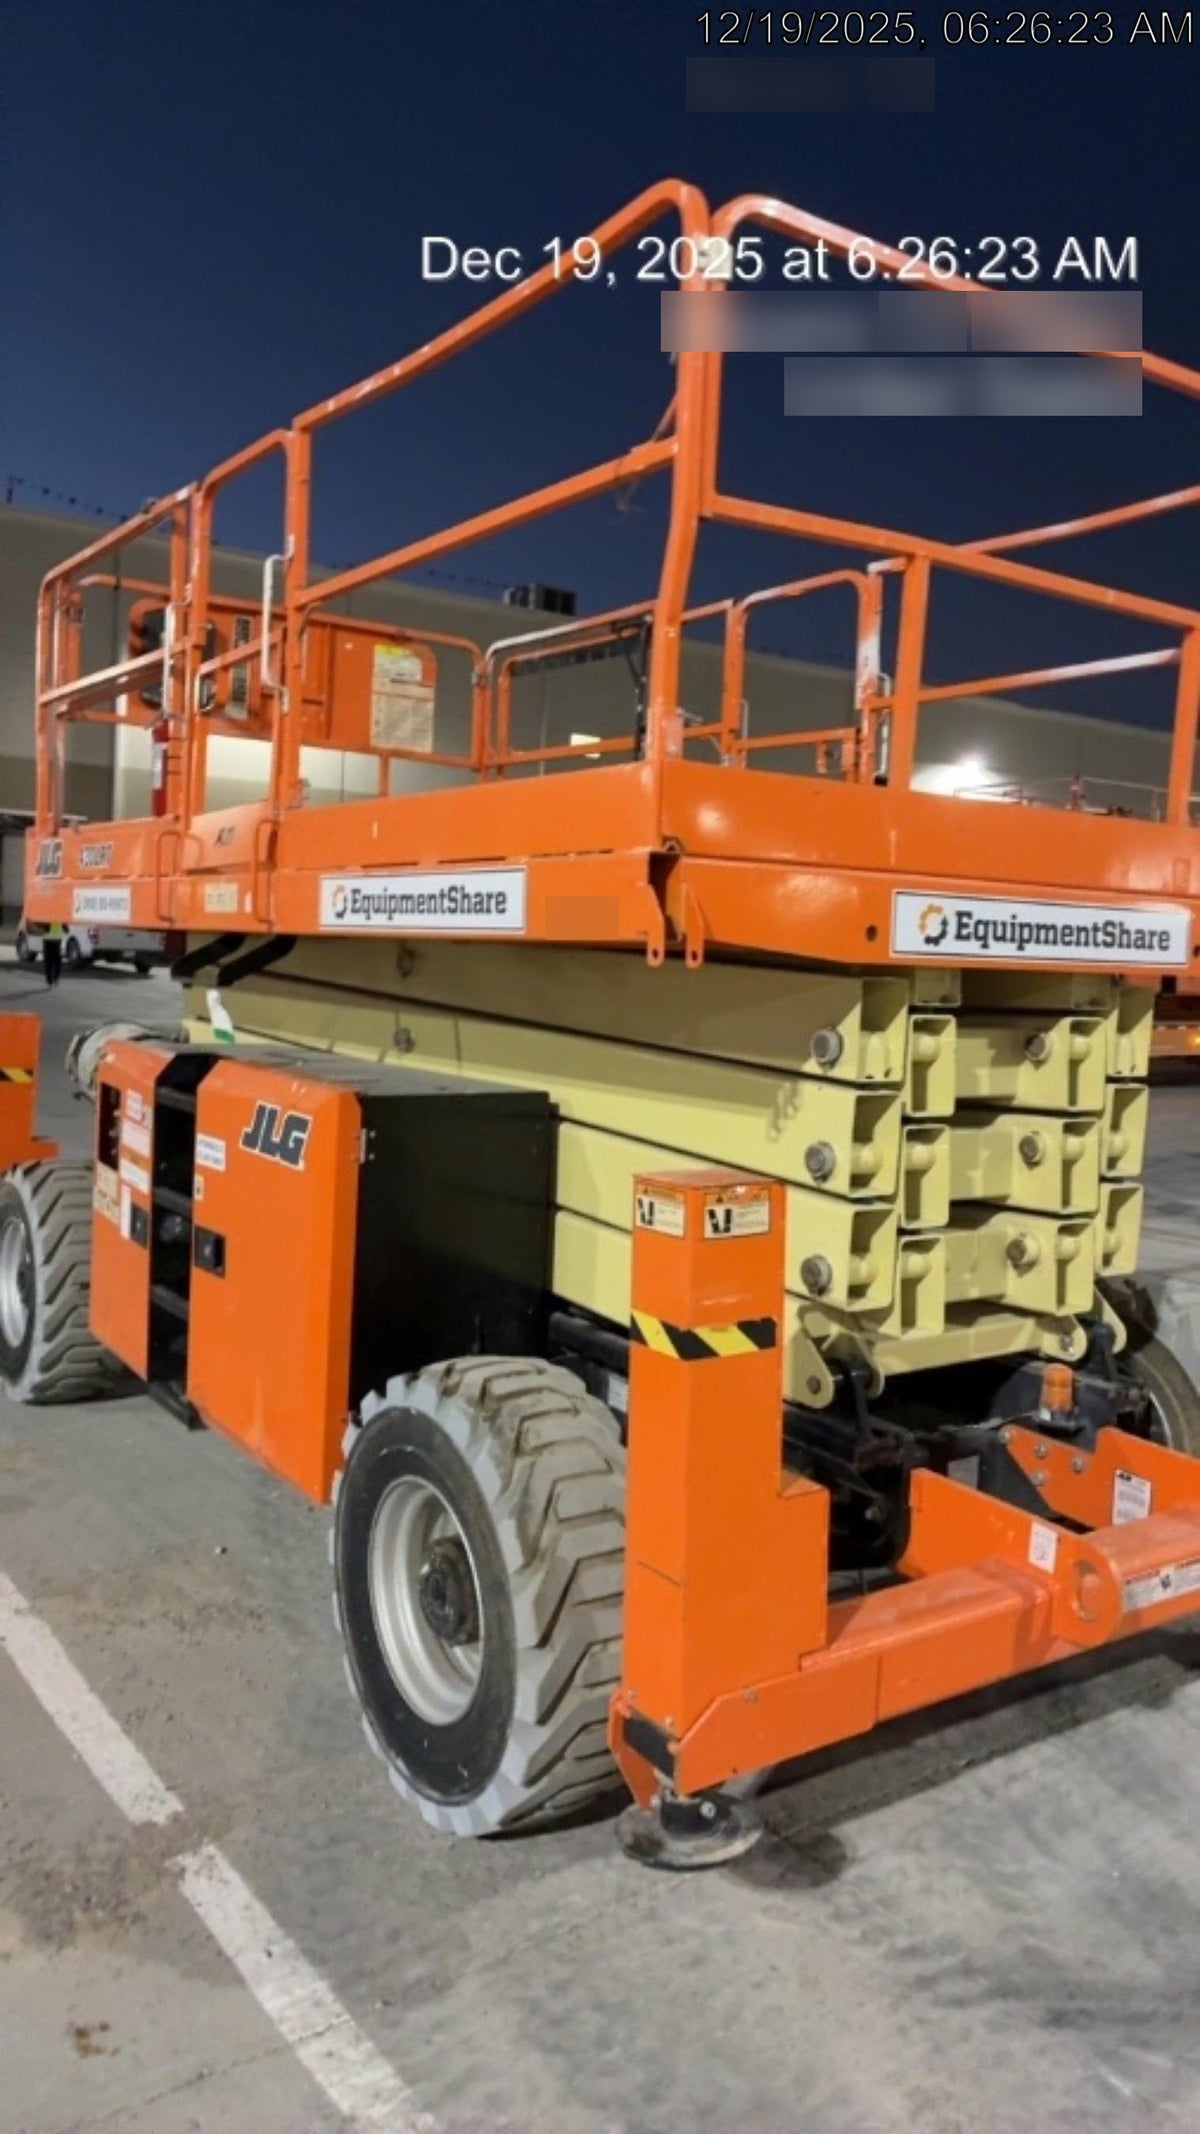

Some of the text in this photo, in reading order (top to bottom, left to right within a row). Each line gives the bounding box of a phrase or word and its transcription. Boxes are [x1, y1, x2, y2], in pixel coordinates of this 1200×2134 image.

[350, 885, 507, 921] EquipmentShare
[954, 909, 1171, 952] EquipmentShare
[241, 1102, 311, 1168] JLG
